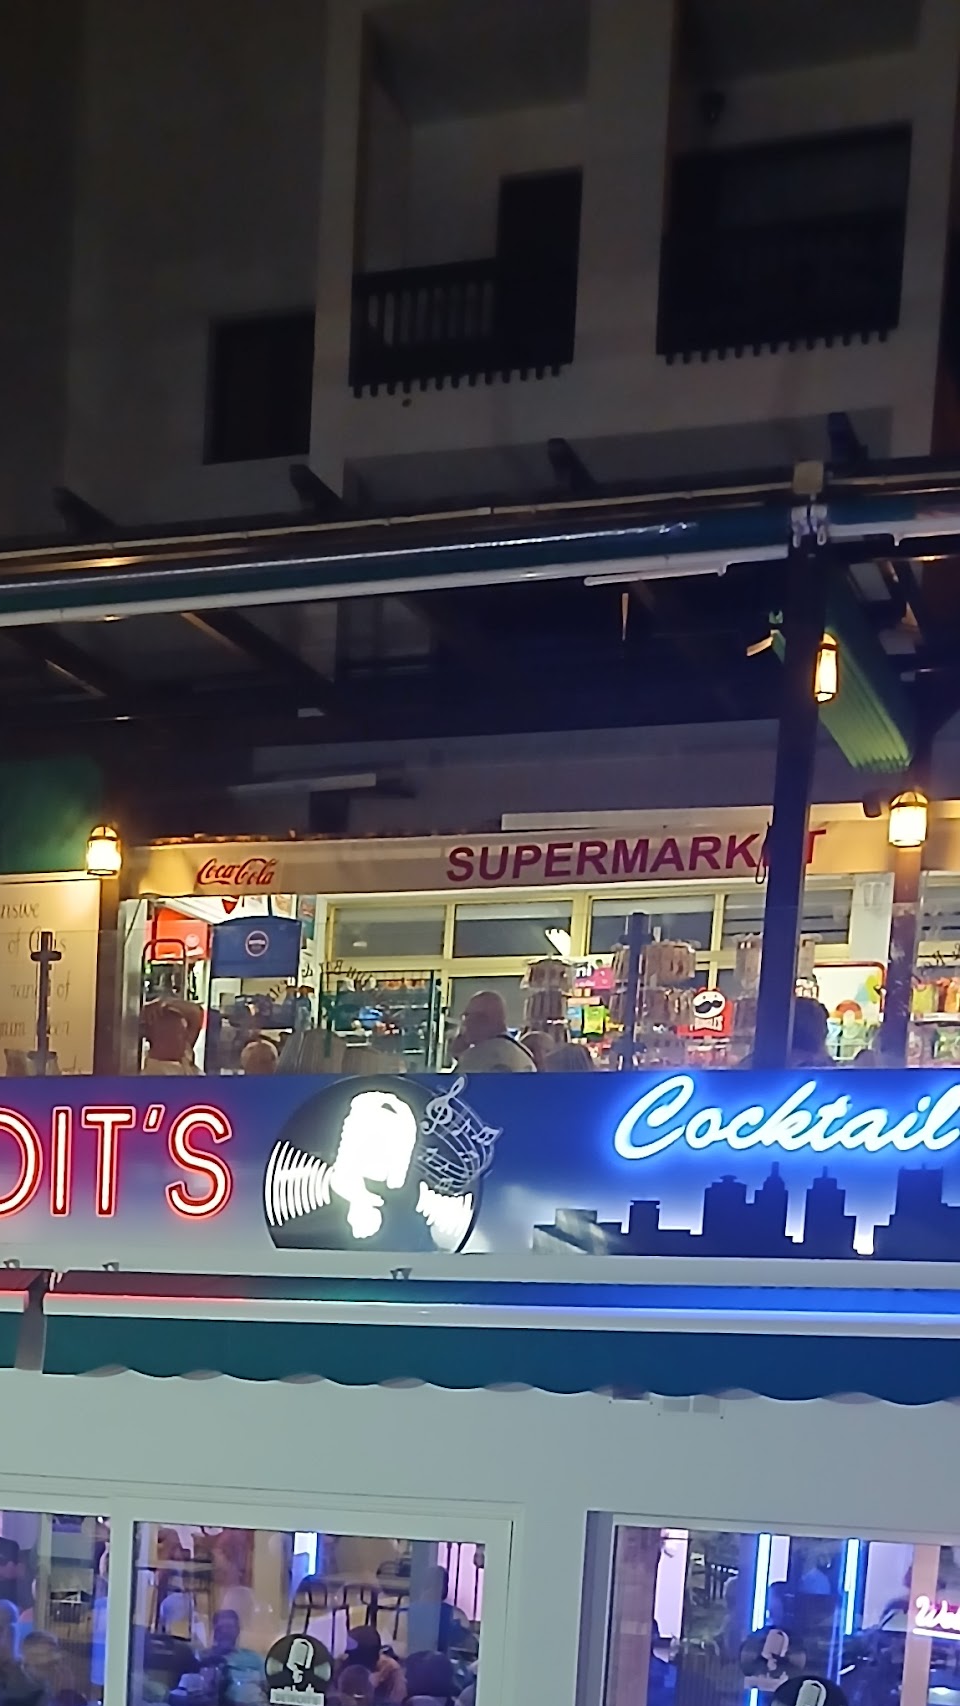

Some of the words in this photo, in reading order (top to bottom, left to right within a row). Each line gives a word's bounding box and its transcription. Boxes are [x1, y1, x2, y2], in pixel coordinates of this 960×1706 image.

[197, 858, 279, 886] Coca-Cola
[446, 829, 827, 882] SUPERMARKT
[614, 1074, 960, 1160] Cocktail
